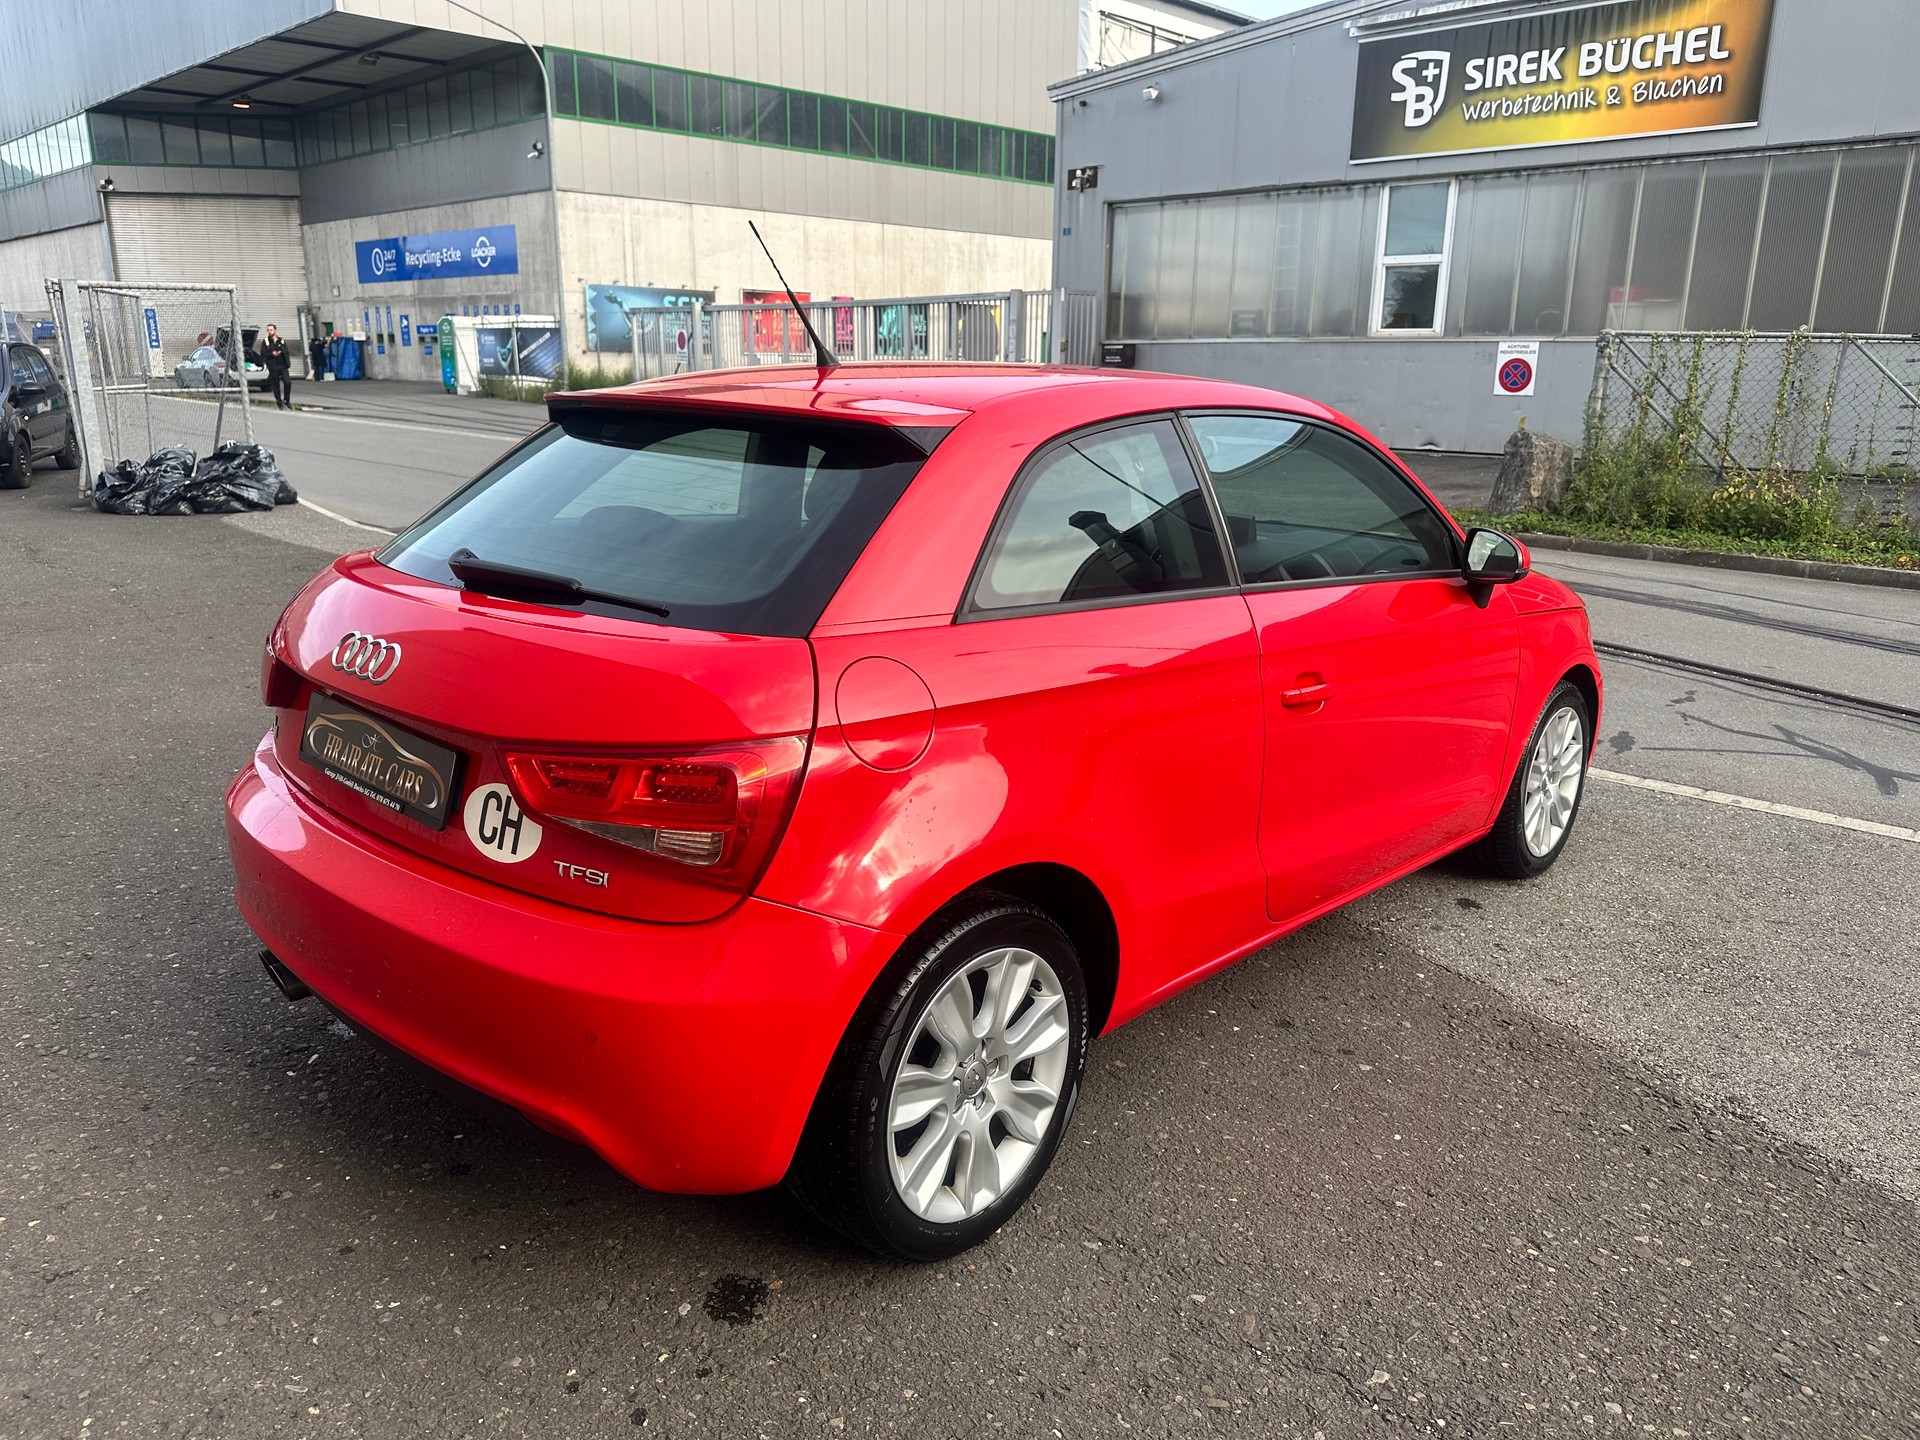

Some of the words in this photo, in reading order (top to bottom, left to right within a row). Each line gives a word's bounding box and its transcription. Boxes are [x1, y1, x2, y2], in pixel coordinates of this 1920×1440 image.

[1463, 46, 1566, 92] SIREK
[1578, 24, 1730, 78] BÜCHEL
[1462, 87, 1598, 121] Werbetechnik
[1606, 86, 1621, 106] &
[1631, 72, 1724, 104] Blachen
[405, 246, 462, 268] Recycling-Ecke
[471, 246, 497, 258] LOACKER
[478, 790, 524, 856] CH
[553, 860, 610, 888] TFSI
